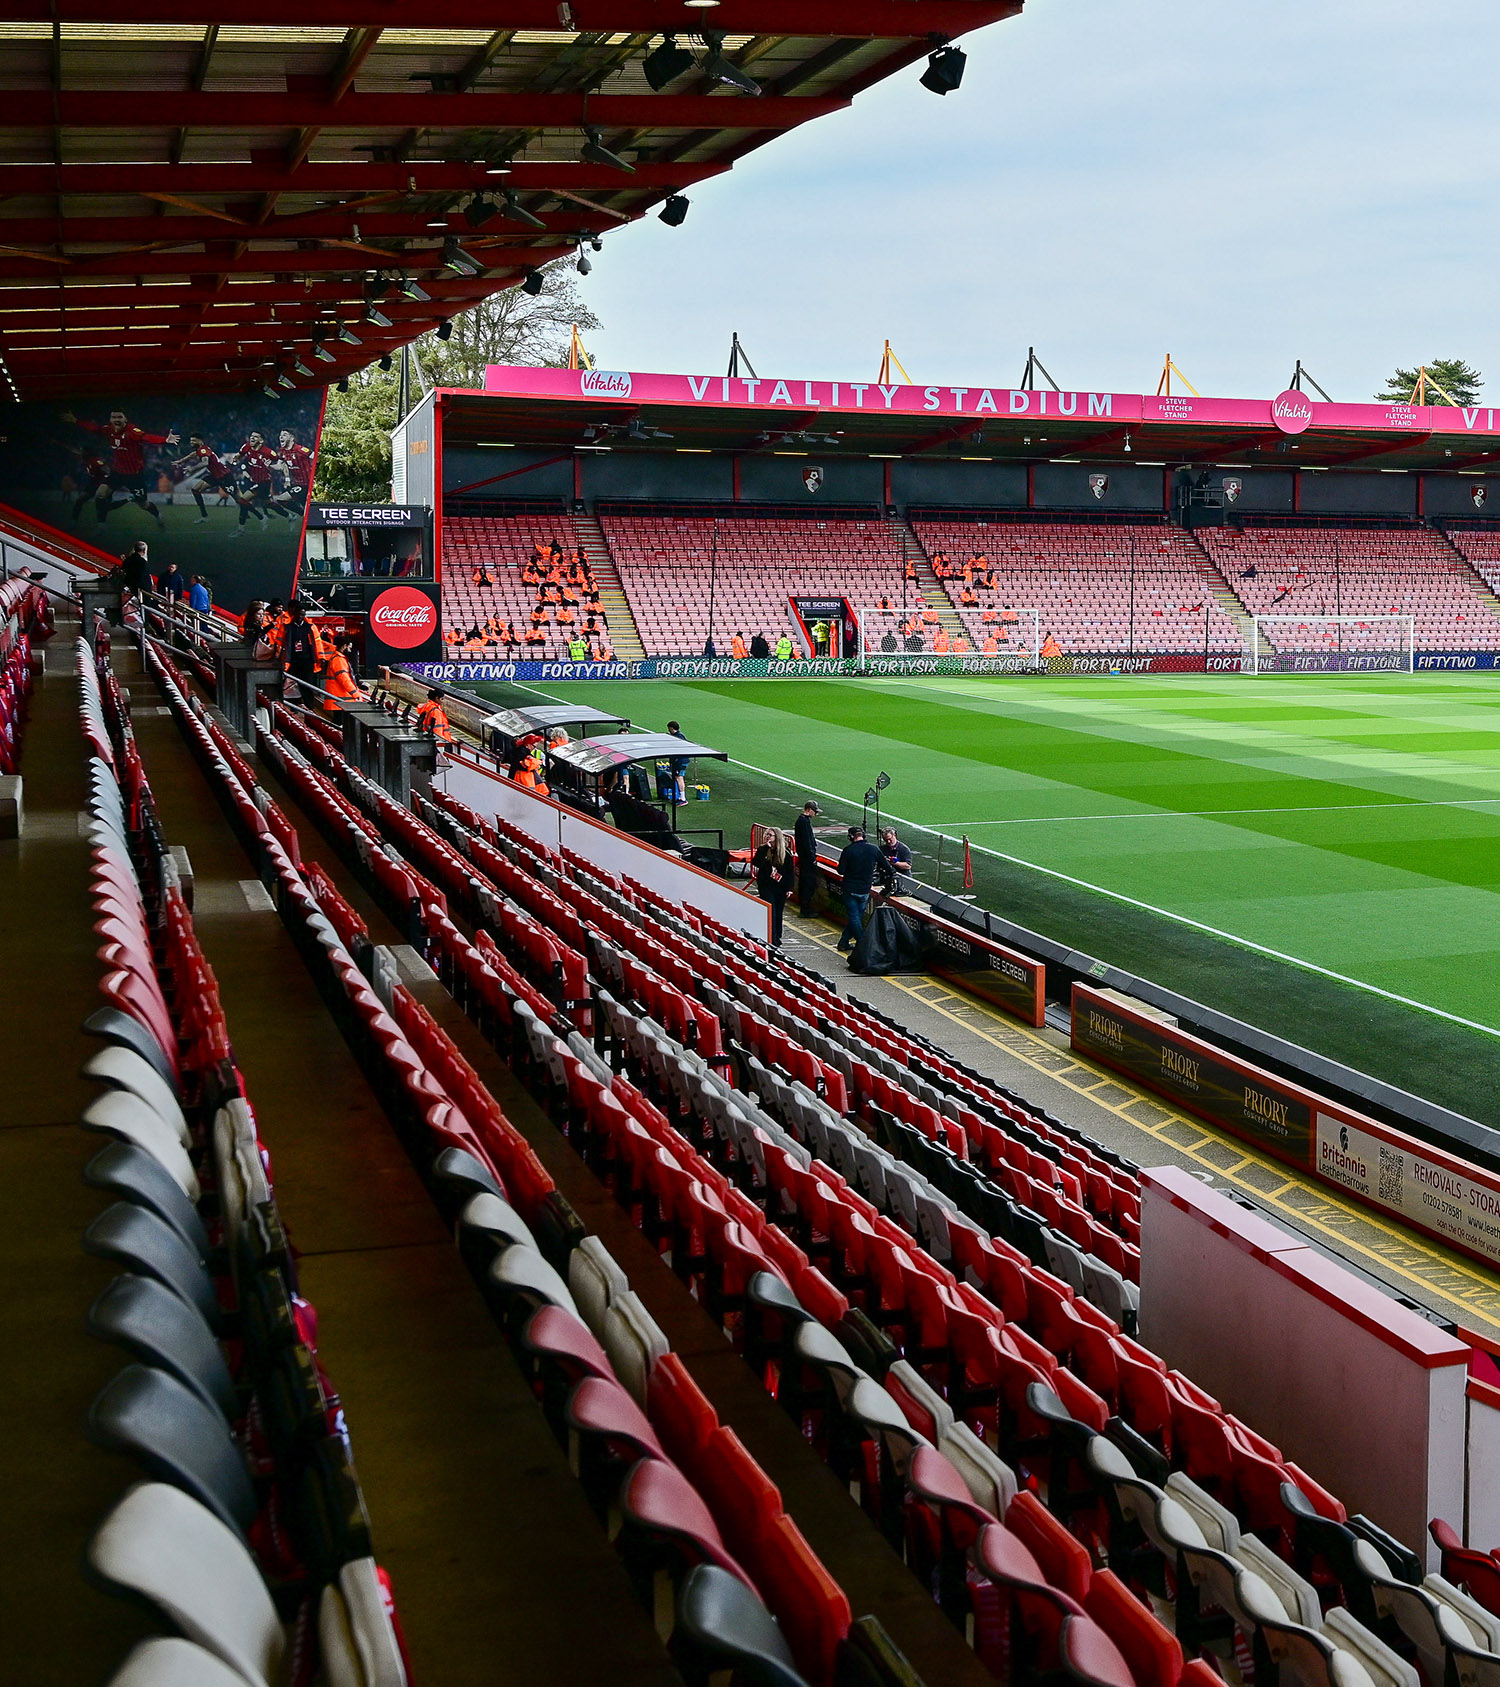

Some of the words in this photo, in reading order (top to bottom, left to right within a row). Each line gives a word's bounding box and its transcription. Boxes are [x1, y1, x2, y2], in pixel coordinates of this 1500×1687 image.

[583, 372, 631, 397] Vitality
[687, 376, 899, 408] VITALITY
[923, 386, 1112, 416] STADIUM
[1158, 404, 1193, 412] FLETCHER
[1165, 398, 1187, 406] STEVE
[1274, 400, 1312, 424] Vitality
[1391, 406, 1411, 414] STEVE
[1164, 411, 1188, 419] STAND
[319, 508, 349, 519] TEE
[352, 509, 411, 520] SCREEN
[375, 605, 433, 624] Coca-Cola
[424, 663, 515, 679] FORTYTWO
[542, 662, 641, 678] FORTYTHREE
[655, 661, 741, 676] FORTYFOUR
[767, 660, 847, 675] FORTYFIVE
[870, 659, 938, 673] FORTYSIX
[1072, 658, 1153, 671] FORTYEIGHT
[1295, 656, 1329, 669] FIFTY
[1347, 656, 1402, 669] FIFTYONE
[1418, 656, 1476, 668] FIFTYTWO
[936, 929, 947, 945] TEE
[947, 935, 971, 956] SCREEN
[988, 953, 1000, 969] TEE
[1001, 960, 1027, 983] SCREEN
[1089, 1010, 1124, 1043] PRIORY
[1161, 1045, 1200, 1081] PRIORY
[1160, 1067, 1182, 1085] CONCEPT
[1182, 1076, 1200, 1092] GROUP
[1244, 1086, 1289, 1126] PRIORY
[1243, 1109, 1268, 1129] CONCEPT
[1269, 1120, 1289, 1137] GROUP
[1321, 1141, 1367, 1178] Britannia
[1318, 1158, 1370, 1195] Leatherbarrows
[1414, 1162, 1462, 1200] REMOVALS
[1422, 1193, 1441, 1211] 01202
[1299, 1205, 1357, 1225] NO
[1436, 1219, 1448, 1231] scan
[1448, 1223, 1457, 1235] the
[1457, 1227, 1466, 1239] QR
[1466, 1231, 1477, 1244] code
[1478, 1236, 1486, 1248] for
[1486, 1242, 1498, 1256] your
